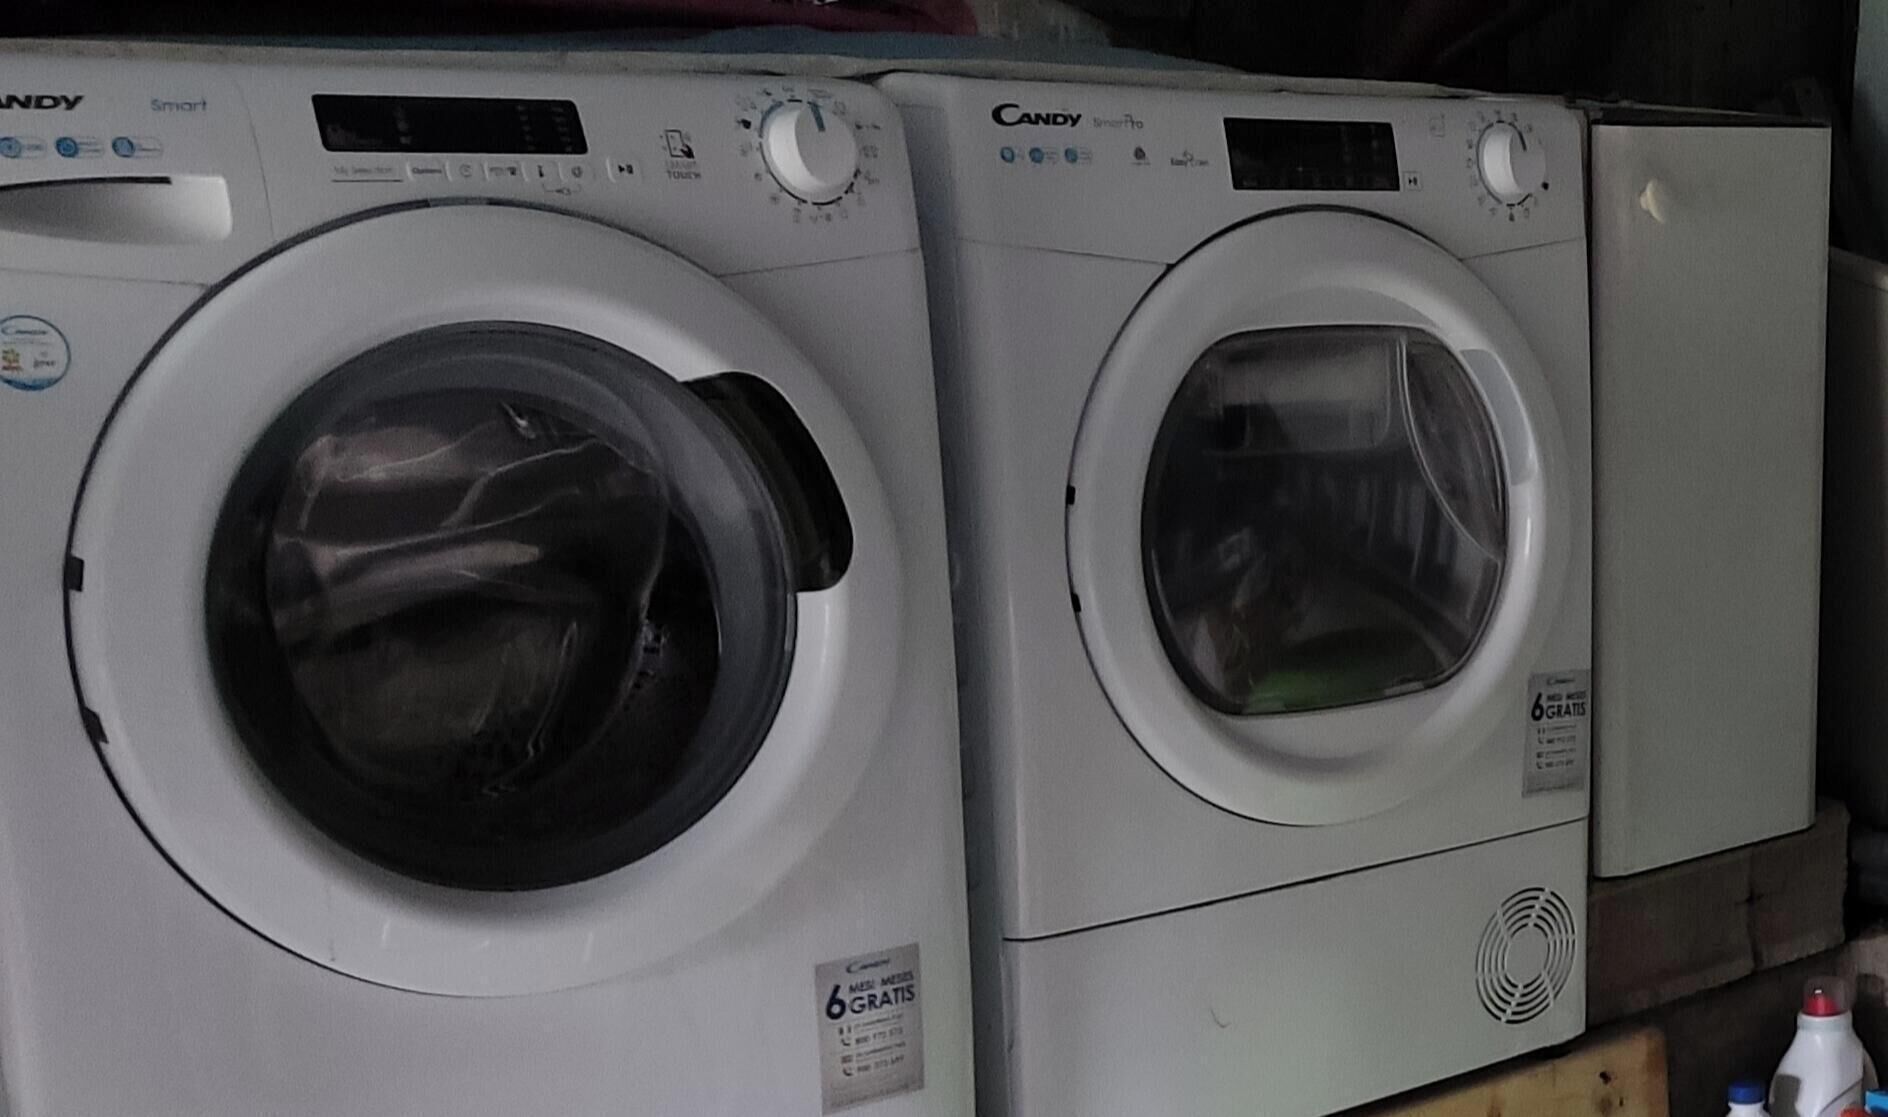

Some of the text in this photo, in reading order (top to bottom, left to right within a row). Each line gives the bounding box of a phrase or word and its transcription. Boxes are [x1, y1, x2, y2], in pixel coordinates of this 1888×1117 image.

[151, 99, 207, 112] Smart
[992, 103, 1082, 129] CANDY
[1531, 692, 1544, 721] 6
[1545, 702, 1586, 719] GRATIS
[826, 984, 846, 1020] 6
[850, 984, 915, 1014] GRATIS
